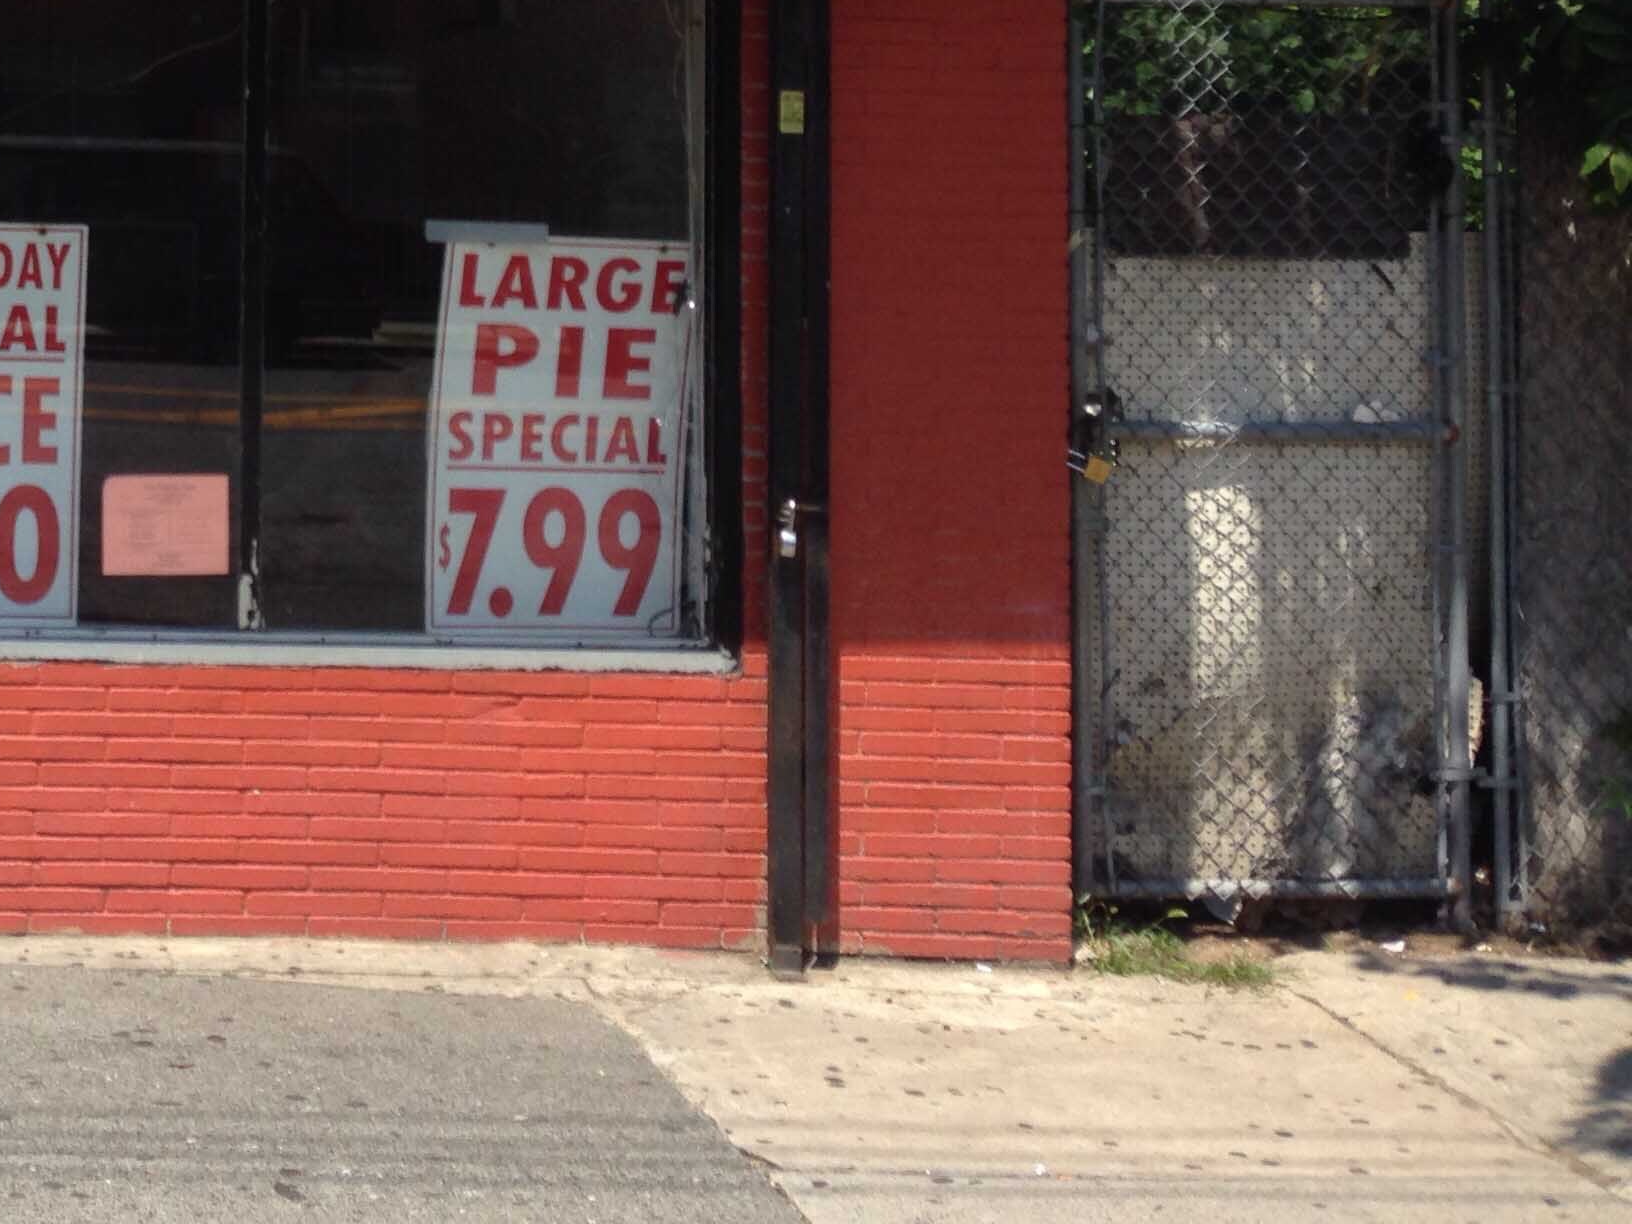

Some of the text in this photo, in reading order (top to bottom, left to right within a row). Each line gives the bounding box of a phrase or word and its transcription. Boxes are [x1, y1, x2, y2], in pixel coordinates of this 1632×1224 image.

[458, 252, 688, 315] LARGE
[471, 321, 657, 401] PIE
[447, 410, 667, 465] SPECIAL
[438, 485, 663, 619] $7.99
